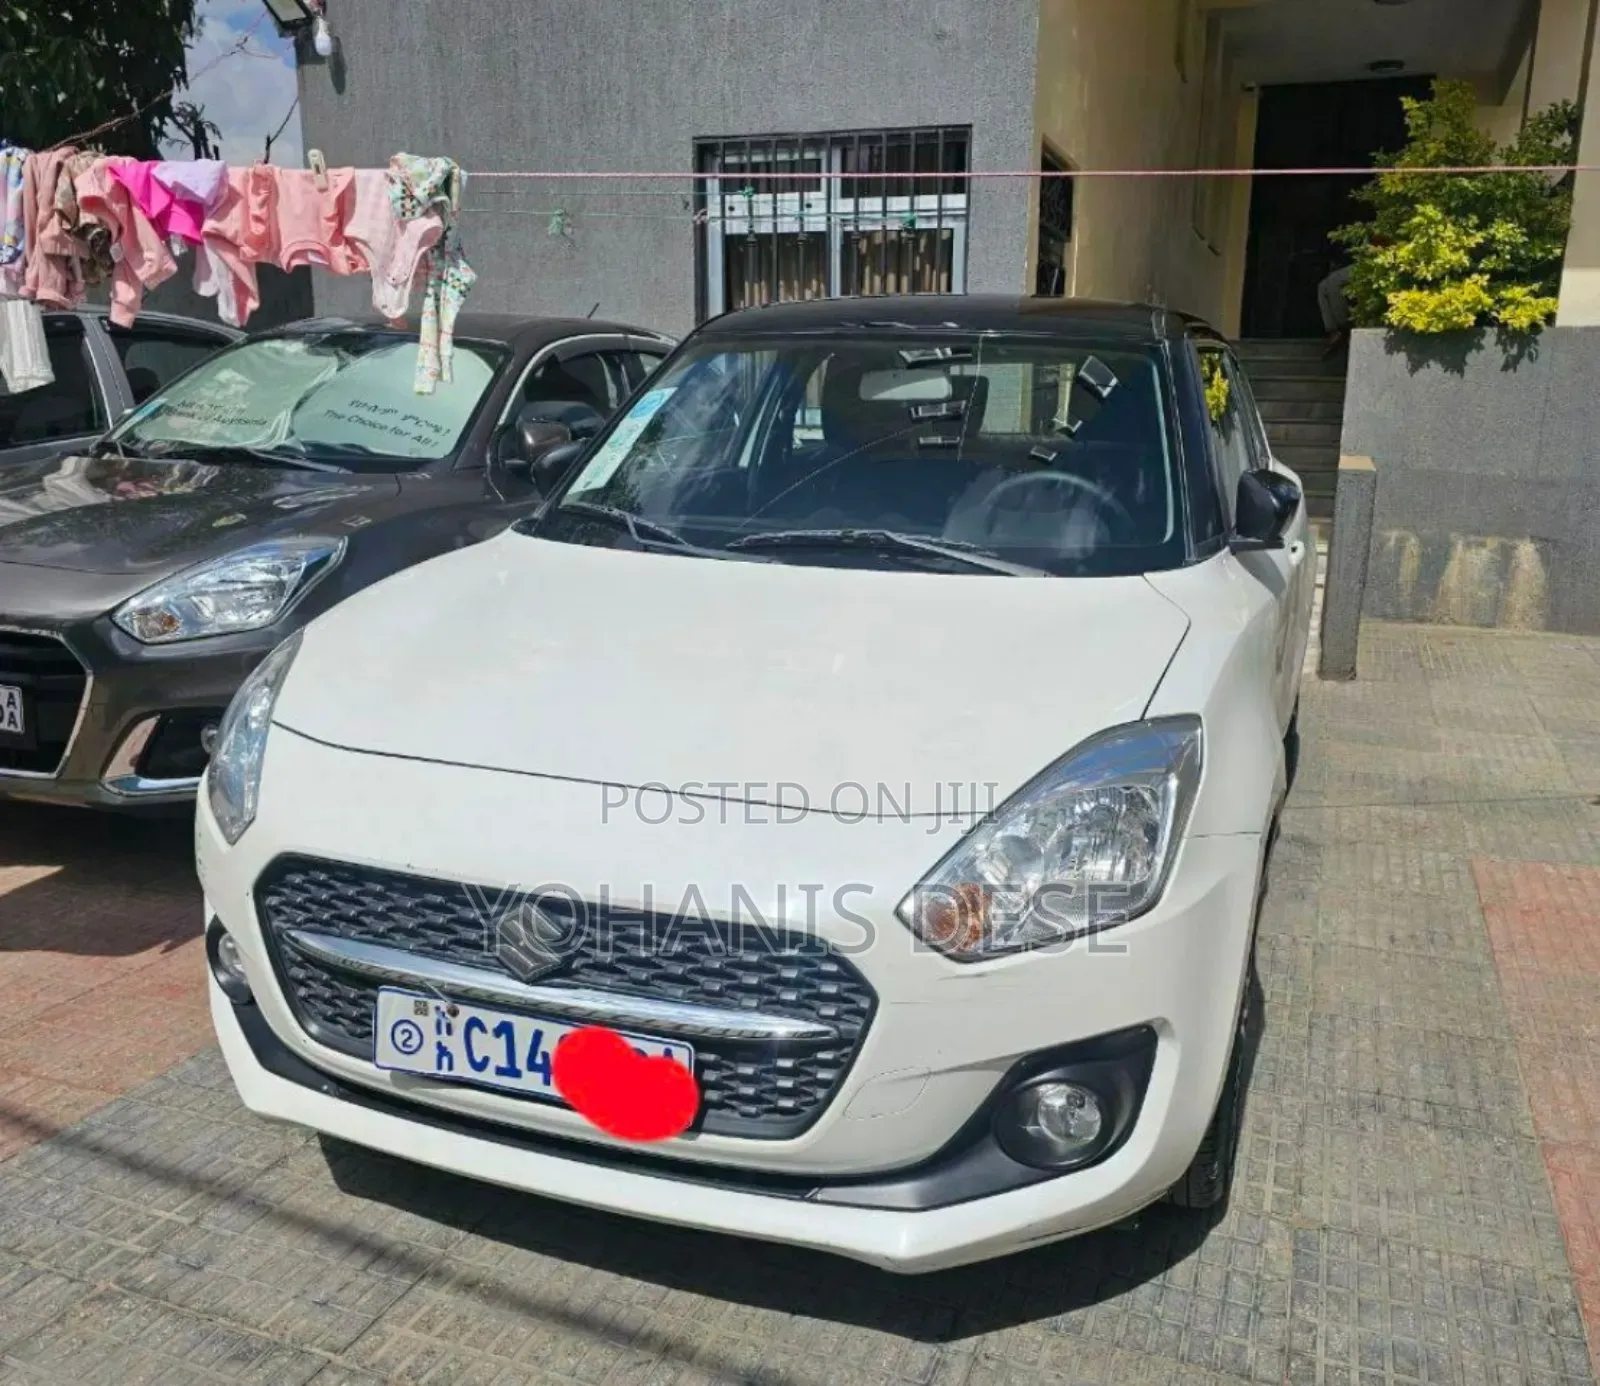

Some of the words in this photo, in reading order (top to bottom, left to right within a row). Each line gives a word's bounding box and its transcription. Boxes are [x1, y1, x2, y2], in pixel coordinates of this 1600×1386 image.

[347, 415, 388, 431] Choice
[7, 691, 17, 709] A
[7, 711, 18, 728] A
[400, 1028, 413, 1048] 2
